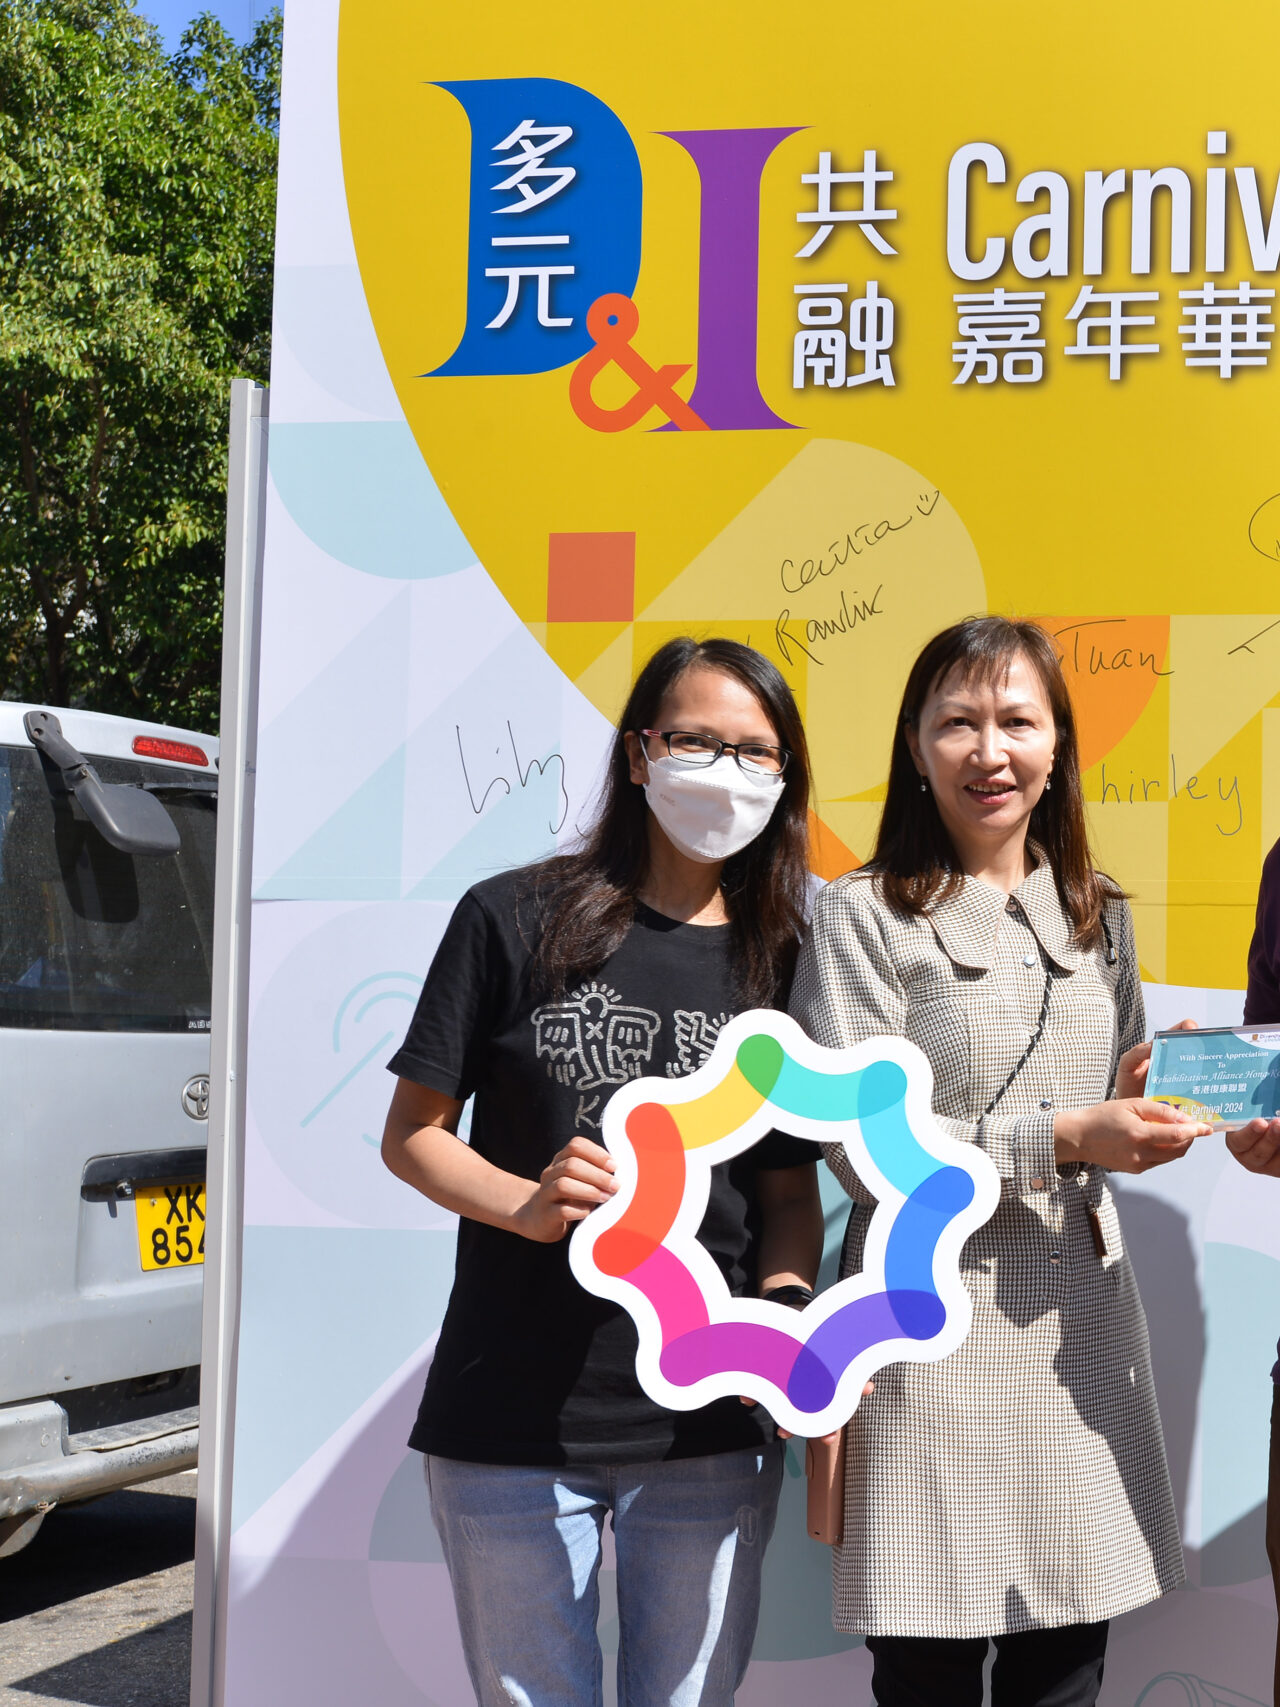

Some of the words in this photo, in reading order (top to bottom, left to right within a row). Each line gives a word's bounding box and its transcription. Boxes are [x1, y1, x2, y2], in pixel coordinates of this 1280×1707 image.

[484, 119, 577, 329] 多元
[793, 150, 899, 389] 共融
[952, 282, 1276, 385] 嘉年華
[1102, 754, 1243, 836] hirley
[1153, 1073, 1208, 1084] Rehabilitation
[1209, 1070, 1243, 1081] Alliance
[1243, 1069, 1267, 1079] Hong
[1198, 1053, 1223, 1061] Sincere
[1224, 1051, 1269, 1060] Appreciation
[1191, 1102, 1223, 1114] Carnival
[1224, 1102, 1244, 1113] 2024
